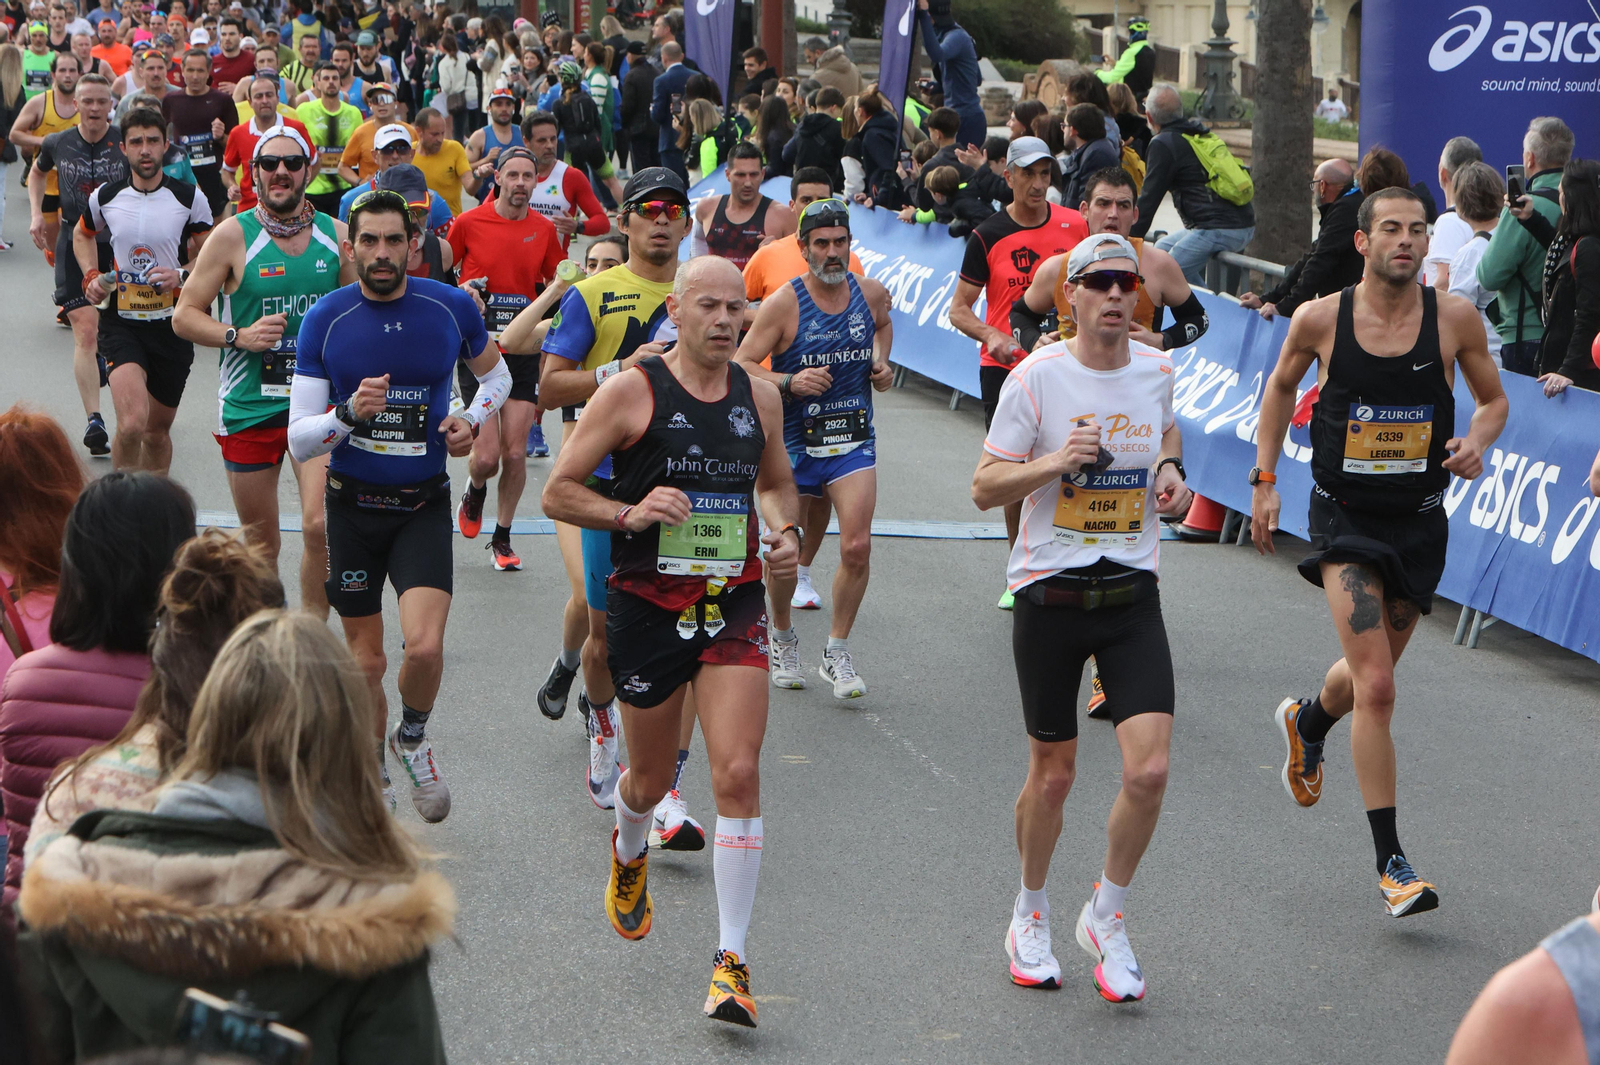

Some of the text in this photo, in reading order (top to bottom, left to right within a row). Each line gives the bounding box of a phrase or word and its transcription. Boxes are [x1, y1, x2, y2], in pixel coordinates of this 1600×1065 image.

[1491, 20, 1600, 63] asics
[1480, 77, 1526, 92] sound
[1527, 78, 1561, 93] mind,
[1563, 79, 1596, 92] sound
[137, 290, 154, 299] 4407
[497, 296, 527, 304] ZURICH
[602, 291, 641, 304] Mercury
[129, 302, 163, 310] SEBASTIEN
[599, 304, 637, 318] Runners
[496, 311, 514, 320] 3267
[800, 346, 871, 366] ALMUÑÉCAR
[386, 390, 422, 400] URICH
[824, 398, 860, 411] ZURICH
[375, 412, 403, 424] 2395
[1378, 410, 1424, 419] ZURICH
[824, 418, 848, 430] 2922
[1105, 413, 1154, 441] Paco
[371, 429, 405, 440] CARPIN
[1375, 431, 1404, 442] 4339
[1119, 443, 1150, 453] SECOS
[1370, 449, 1405, 459] LEGEND
[665, 457, 758, 480] John Turkey
[1092, 474, 1139, 486] ZURICH
[1469, 447, 1561, 545] asics
[695, 497, 740, 510] ZURICH
[1088, 500, 1117, 512] 4164
[692, 524, 722, 538] 1366
[1083, 520, 1117, 531] NACHO
[694, 546, 718, 557] ERNI
